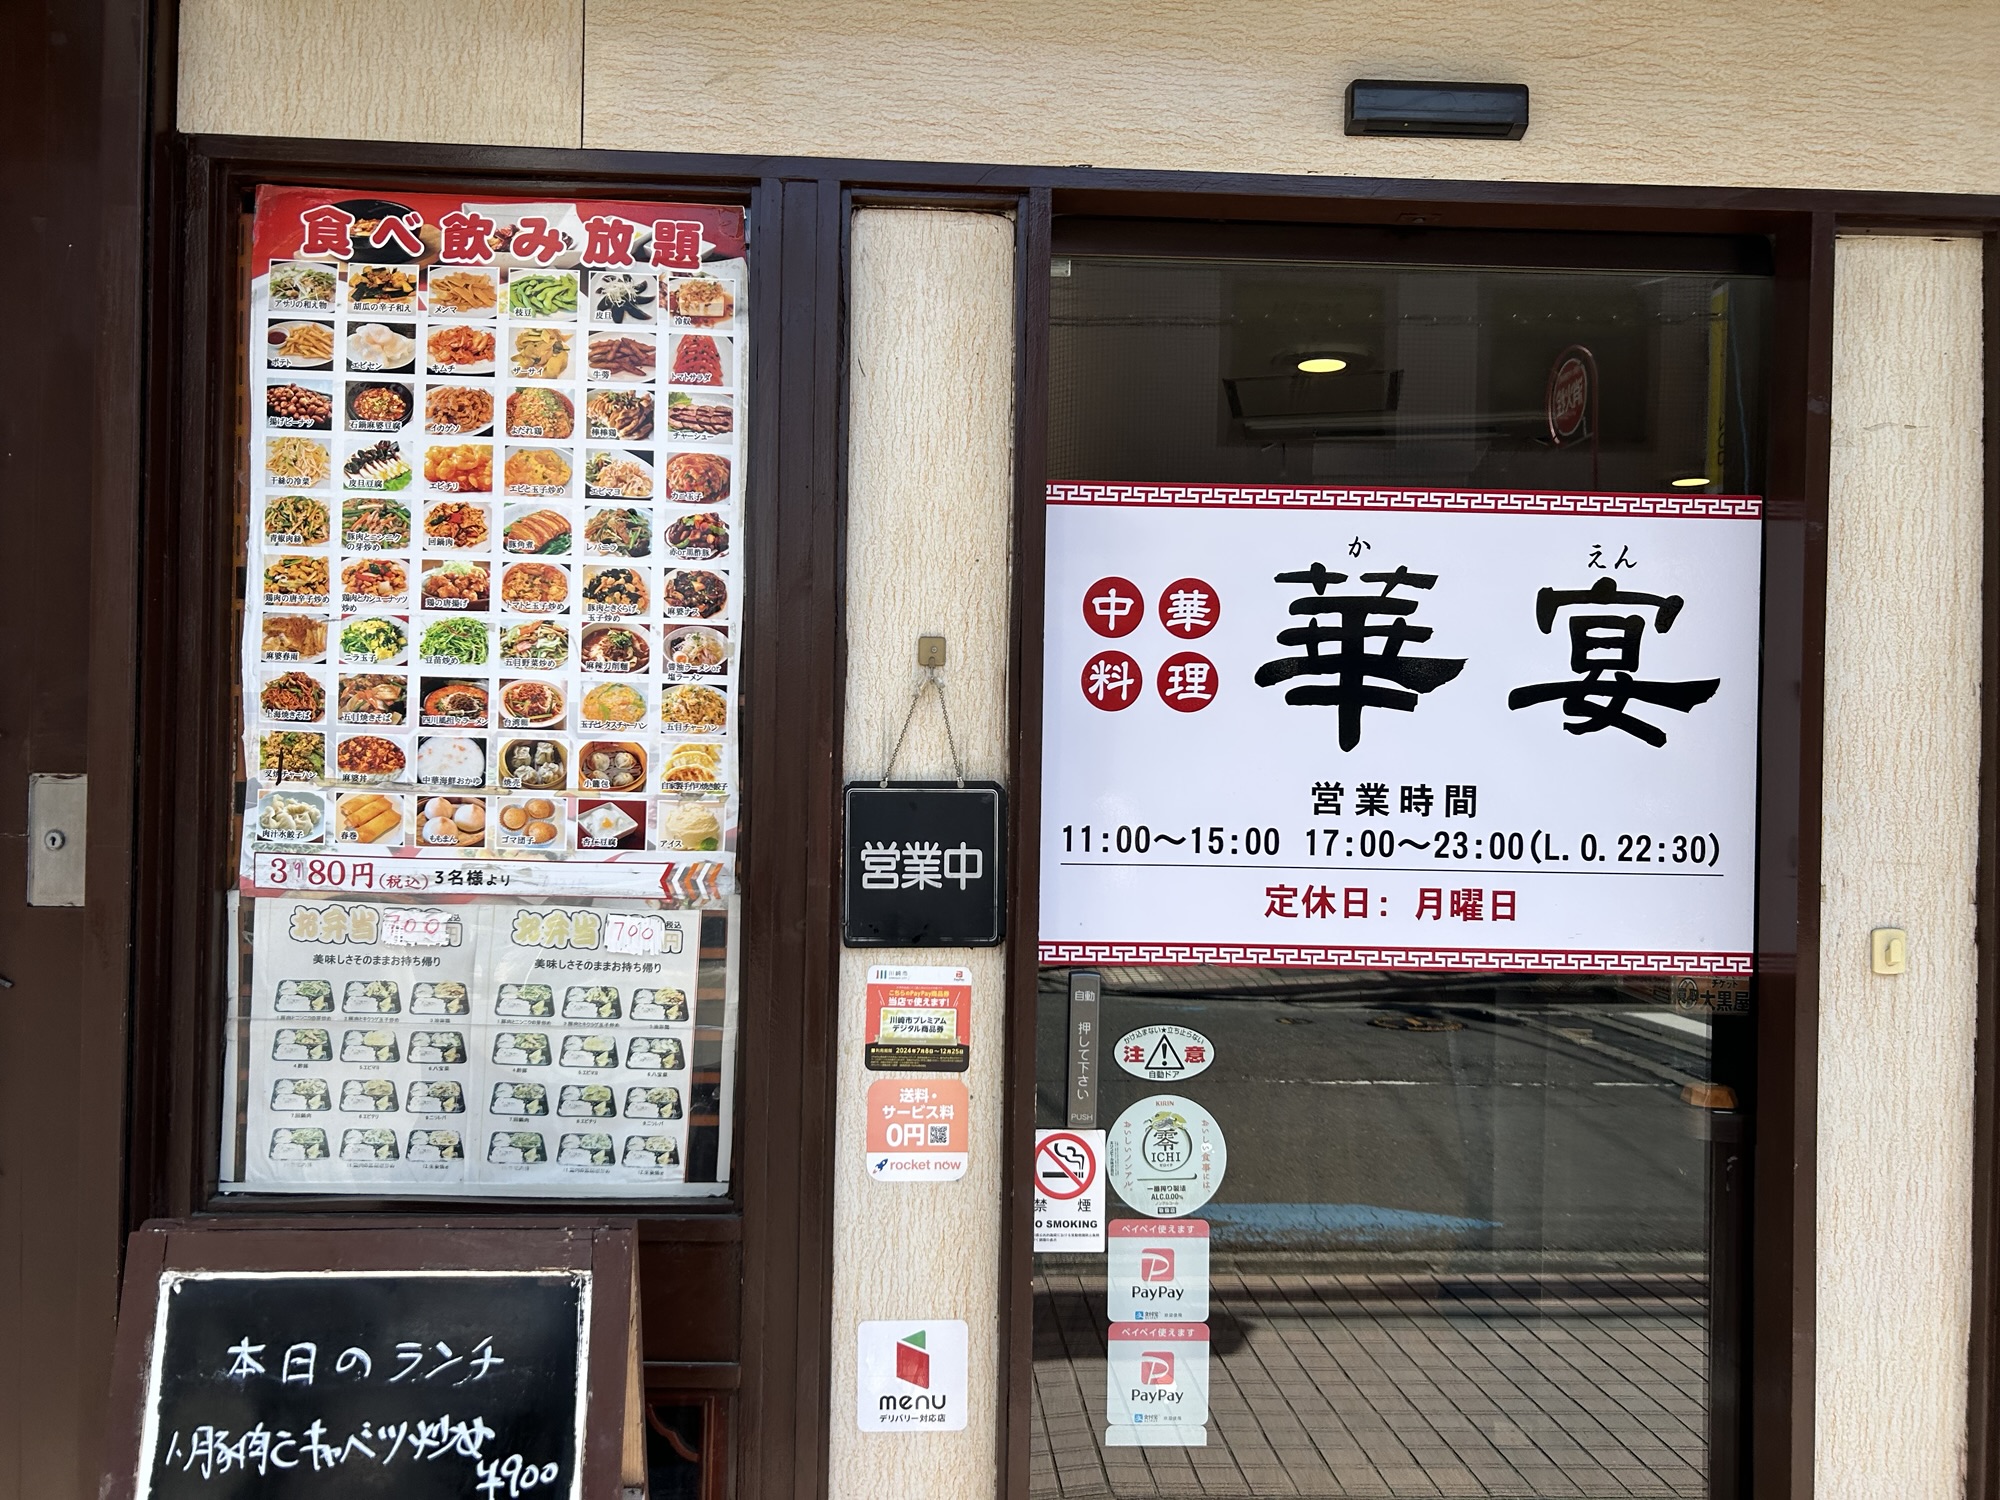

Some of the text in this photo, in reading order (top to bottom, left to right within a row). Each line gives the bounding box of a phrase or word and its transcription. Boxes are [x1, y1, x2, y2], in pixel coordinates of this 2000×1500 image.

[301, 205, 703, 271] 食べ飲み放題
[275, 300, 327, 309] アサリの和え物
[353, 303, 412, 312] 胡瓜の辛子和え
[515, 308, 532, 317] 枝豆
[674, 317, 691, 326] 冷奴
[351, 361, 382, 370] エビセン
[432, 365, 455, 373] キムチ
[512, 367, 543, 376] ザーサイ
[670, 373, 711, 382] トマトサラダ
[511, 427, 542, 435] よだれ鶏
[429, 482, 458, 490] エビチリ
[510, 485, 565, 494] エビと玉子炒め
[590, 487, 621, 496] エビマヨ
[347, 533, 400, 542] 豚肉とニンニク
[428, 538, 453, 546] 回鍋肉
[347, 542, 380, 551] の芽炒め
[586, 543, 618, 551] レバニラ
[1348, 536, 1371, 558] か
[1587, 544, 1637, 569] えん
[265, 594, 329, 603] 鶏肉の唐辛子炒め
[342, 594, 408, 604] 鶏肉とカシューナッツ
[341, 604, 357, 612] 炒め
[426, 599, 469, 608] 鶏の唐揚げ
[506, 601, 564, 610] トマトと玉子炒め
[667, 607, 700, 615] 麻婆ナス
[588, 614, 620, 622] 玉子炒め
[266, 652, 299, 661] 麻婆春雨
[344, 654, 377, 663] ニラ玉子
[425, 656, 459, 664] 豆苗炒め
[1255, 562, 1720, 752] 華宴
[505, 659, 556, 668] 五目野菜炒め
[667, 673, 703, 681] 塩ラーメン
[343, 712, 392, 722] 五目焼きそば
[667, 723, 718, 731] 五目チャーハン
[342, 774, 367, 783] 麻婆丼
[422, 776, 481, 785] 中華海鮮おかゆ
[1311, 781, 1477, 818] 営業時間
[262, 830, 304, 840] 肉汁水餃子
[341, 831, 357, 840] 春巻
[429, 834, 457, 843] ももまん
[660, 840, 682, 848] アイス
[861, 841, 983, 891] 営業中
[435, 869, 510, 886] 3名様より
[290, 905, 379, 944] お弁当
[513, 910, 601, 949] お弁当
[313, 954, 441, 967] 美味しさそのままお持ち帰り
[535, 959, 661, 973] 美味しさそのままお持ち帰り
[1074, 991, 1095, 1002] 自動
[1700, 990, 1749, 1011] 大黒屋
[888, 997, 950, 1006] 当店で使えます!
[889, 1016, 947, 1025] 川崎市プレミアム
[892, 1025, 944, 1033] デジタル商品券
[1077, 1022, 1091, 1100] 押して下さい
[1149, 1070, 1179, 1079] 自動ドア
[882, 1104, 954, 1120] サービス料
[1071, 1113, 1094, 1121] PUSH
[886, 1123, 925, 1147] 0円
[1151, 1152, 1181, 1162] ICHI
[890, 1159, 962, 1170] rocket now
[1046, 1219, 1098, 1228] SMOKING
[1122, 1225, 1195, 1234] ペイペイ使えます
[1132, 1286, 1184, 1301] PayPay
[1121, 1328, 1195, 1337] ペイペイ使えます
[228, 1336, 504, 1386] 本日のランチ
[1131, 1389, 1184, 1404] PayPay
[879, 1395, 946, 1410] menu
[879, 1414, 946, 1423] デリバリー対応店
